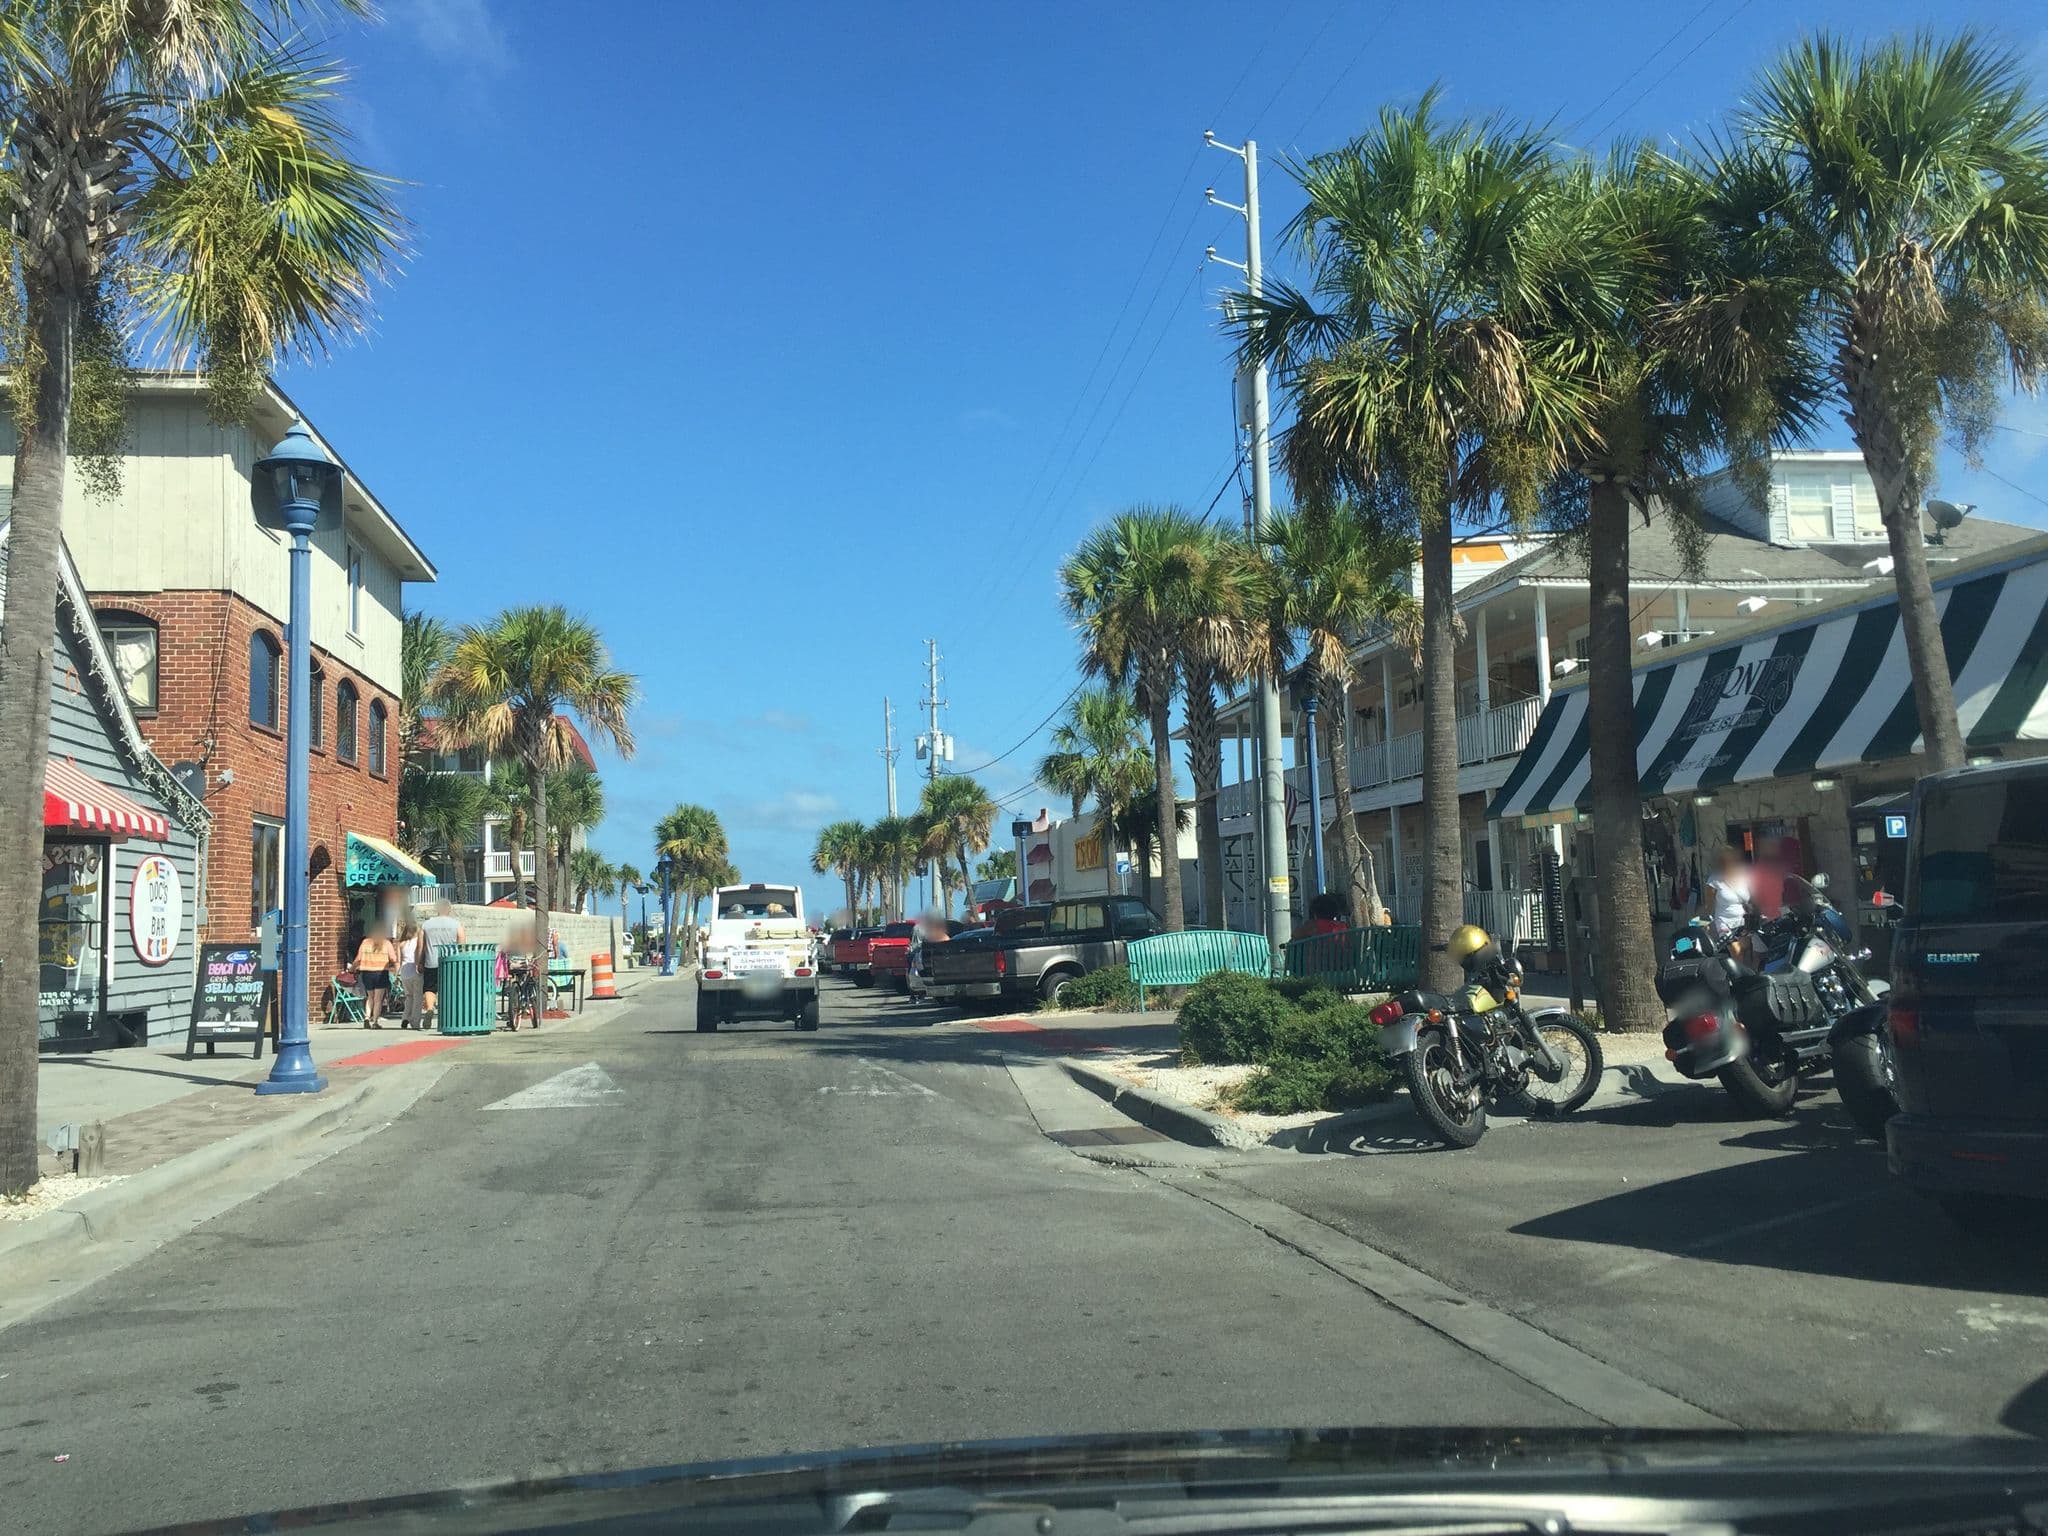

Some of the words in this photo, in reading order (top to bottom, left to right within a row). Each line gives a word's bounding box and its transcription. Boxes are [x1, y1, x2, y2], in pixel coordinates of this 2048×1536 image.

[1891, 819, 1904, 834] P
[358, 863, 376, 872] ICE
[349, 873, 399, 882] CREAM
[149, 881, 169, 905] DOC'S
[151, 916, 166, 937] BAR
[1927, 953, 1980, 963] ELEMENT
[208, 963, 233, 975] BEACH
[236, 962, 256, 975] DAY
[204, 982, 234, 994] JELLO
[205, 995, 217, 1003] ON
[241, 992, 262, 1008] WAY!
